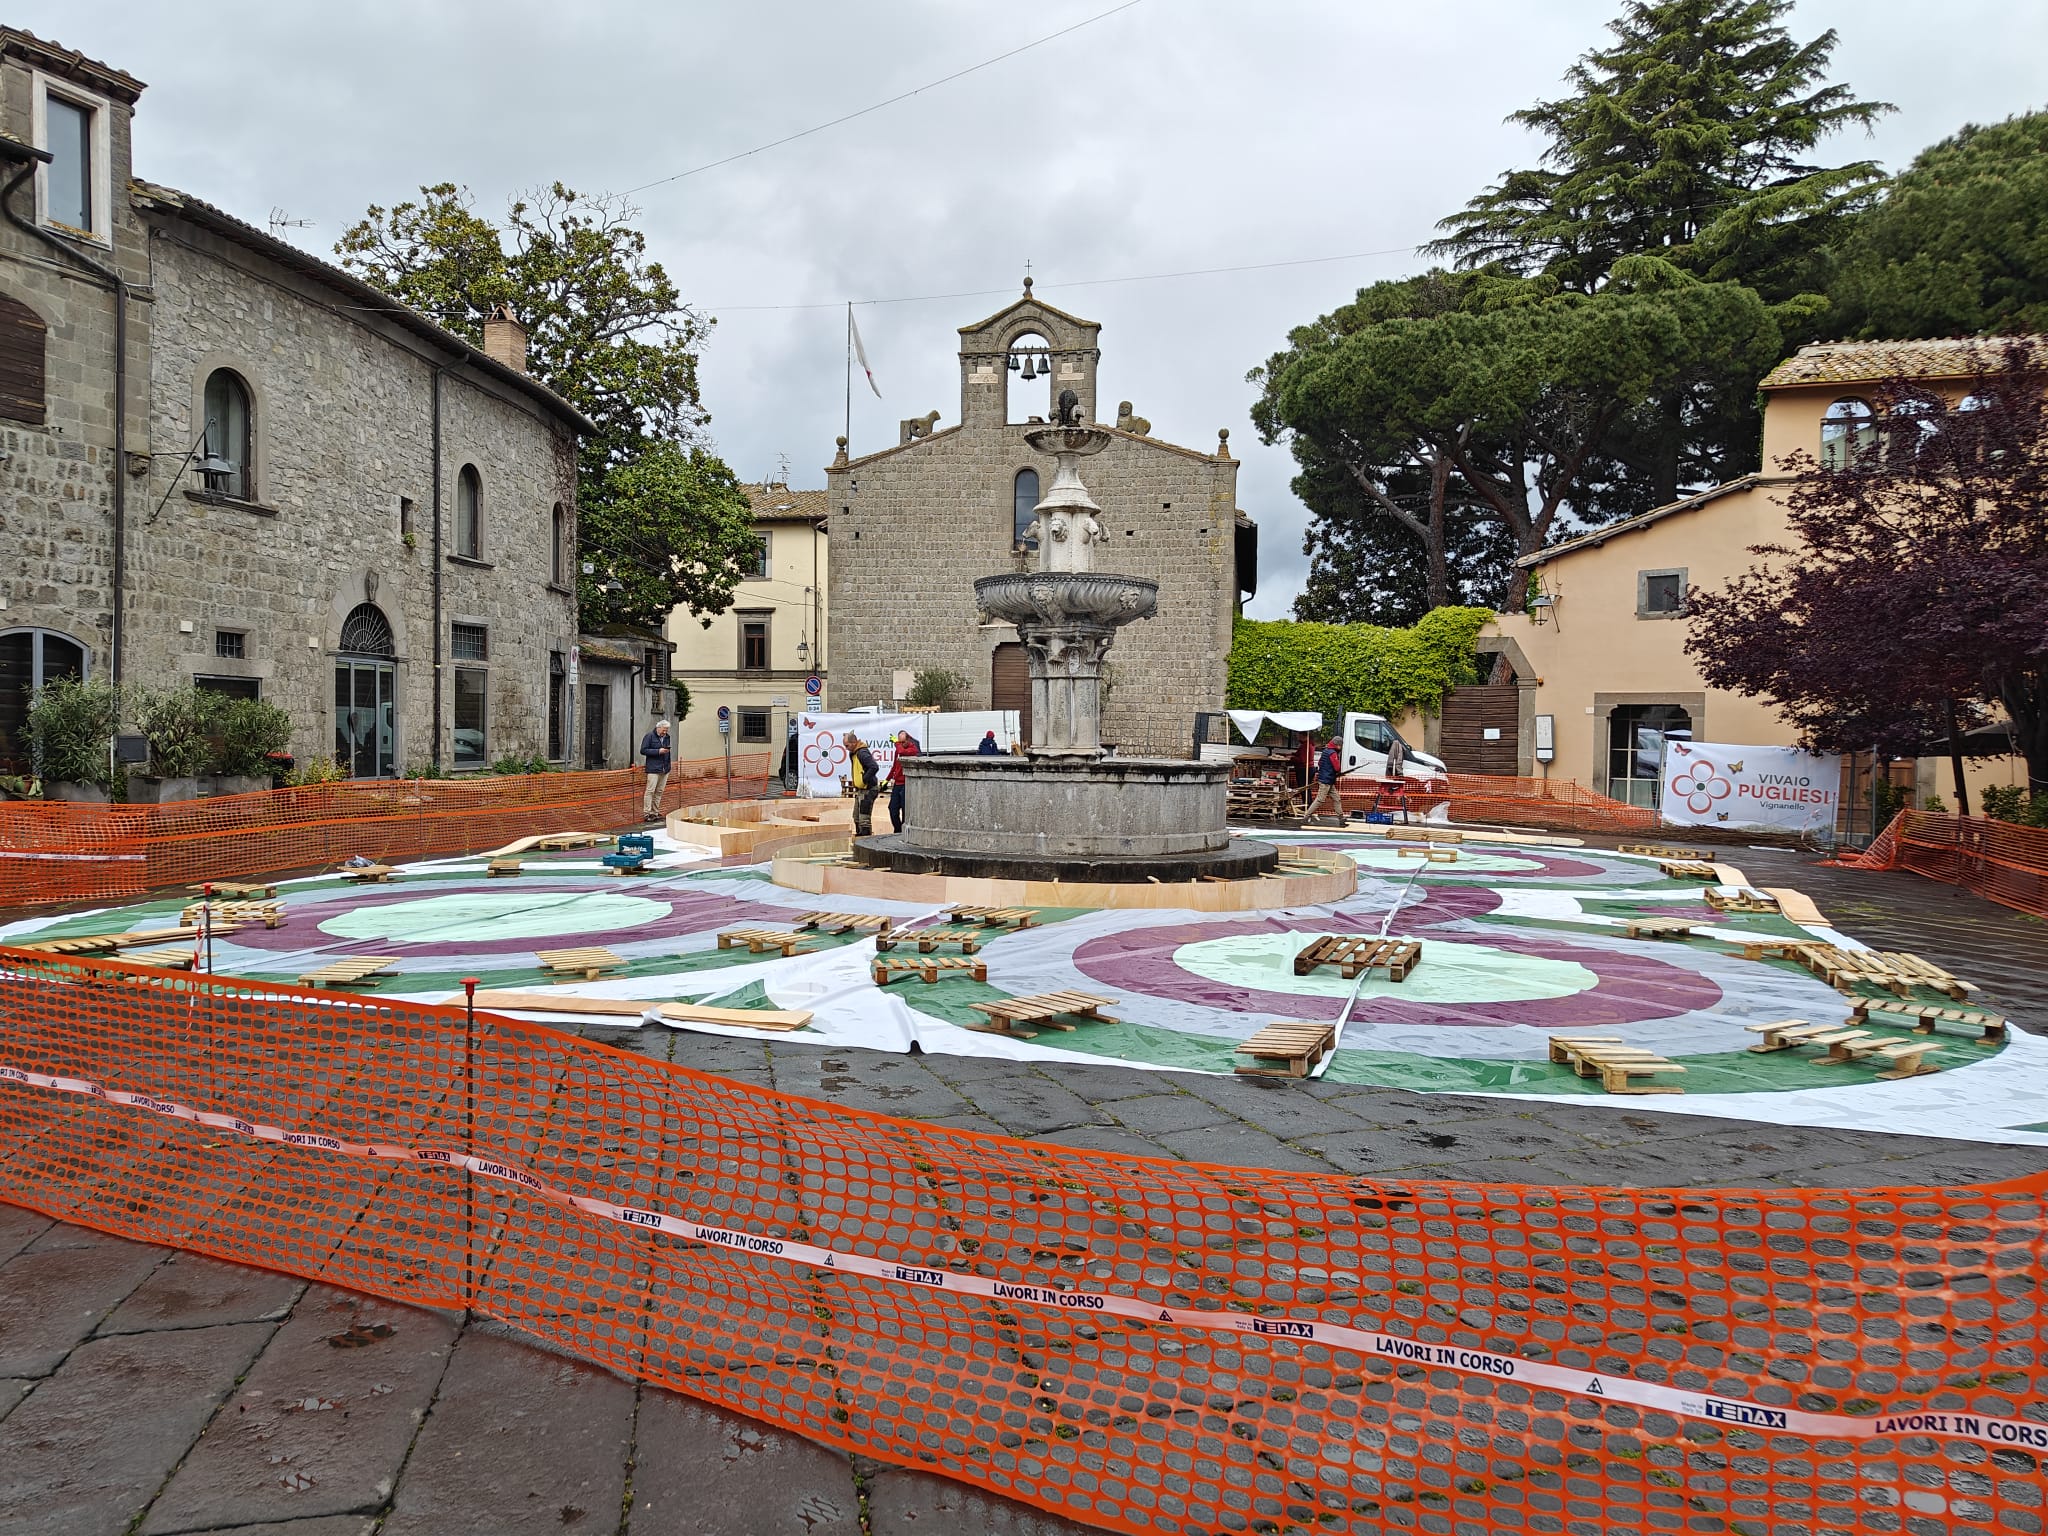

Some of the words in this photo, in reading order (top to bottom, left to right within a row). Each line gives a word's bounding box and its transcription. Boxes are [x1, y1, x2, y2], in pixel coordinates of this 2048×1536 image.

[866, 739, 893, 748] VIVAI
[1758, 773, 1810, 787] VIVAIO
[1738, 783, 1830, 804] PUGLIESI
[1760, 800, 1806, 811] Vignanello
[156, 1103, 175, 1114] ORSO
[307, 1135, 317, 1145] IN
[318, 1136, 341, 1150] CORSO
[418, 1151, 451, 1162] TENAX
[478, 1160, 507, 1178] LAVORI
[508, 1169, 518, 1182] IN
[624, 1210, 661, 1228] TENAX
[695, 1226, 733, 1245] LAVORI
[735, 1234, 747, 1248] IN
[749, 1237, 784, 1255] CORSO
[897, 1267, 942, 1285] TENAX
[993, 1283, 1040, 1302] LAVORI
[1042, 1290, 1057, 1305] IN
[1059, 1293, 1105, 1310] CORSO
[1254, 1319, 1313, 1338] TENAX
[1375, 1336, 1432, 1362] LAVORI
[1436, 1348, 1456, 1365] IN
[1459, 1351, 1515, 1376] CORSO
[1707, 1400, 1785, 1428] TENAX
[1875, 1414, 1948, 1434] LAVORI
[1954, 1416, 1980, 1436] IN
